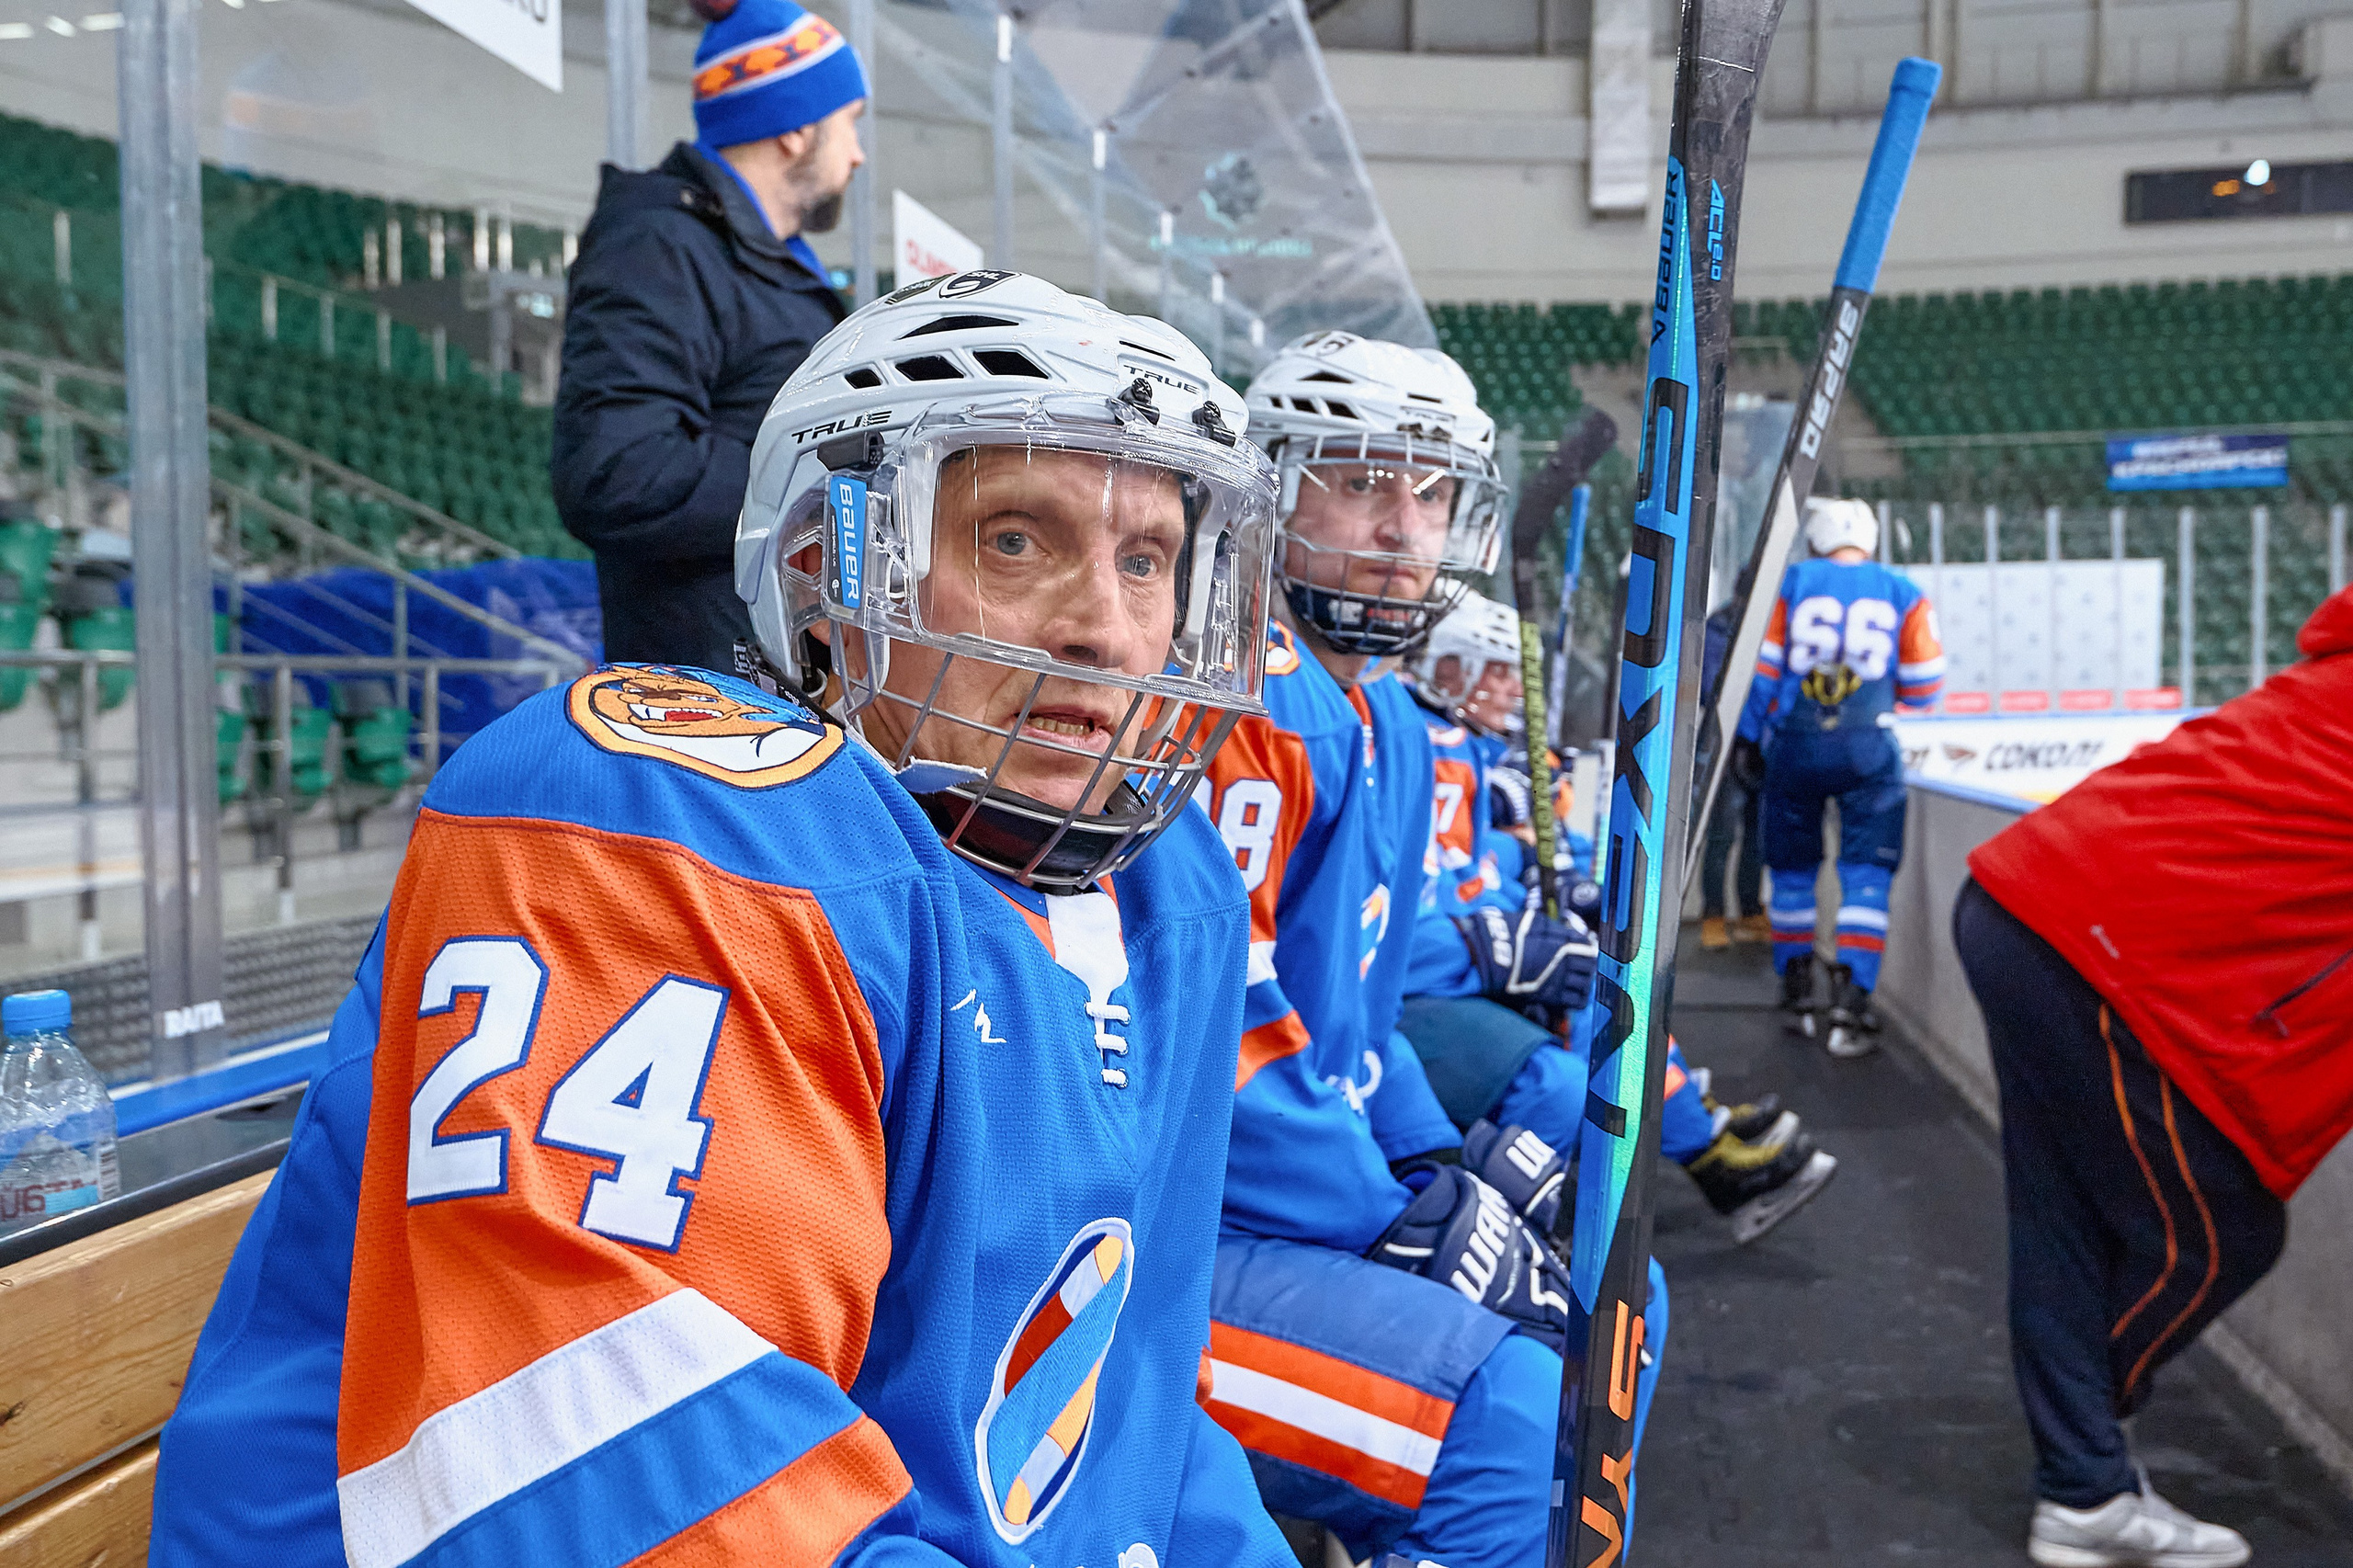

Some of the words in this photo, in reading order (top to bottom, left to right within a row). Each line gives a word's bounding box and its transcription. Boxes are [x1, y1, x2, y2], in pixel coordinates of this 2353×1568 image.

[791, 411, 892, 444] TRUE
[1123, 364, 1199, 395] TRUE
[1585, 377, 1689, 1139] NEXUS
[1188, 775, 1283, 893] 8
[407, 936, 732, 1255] 24
